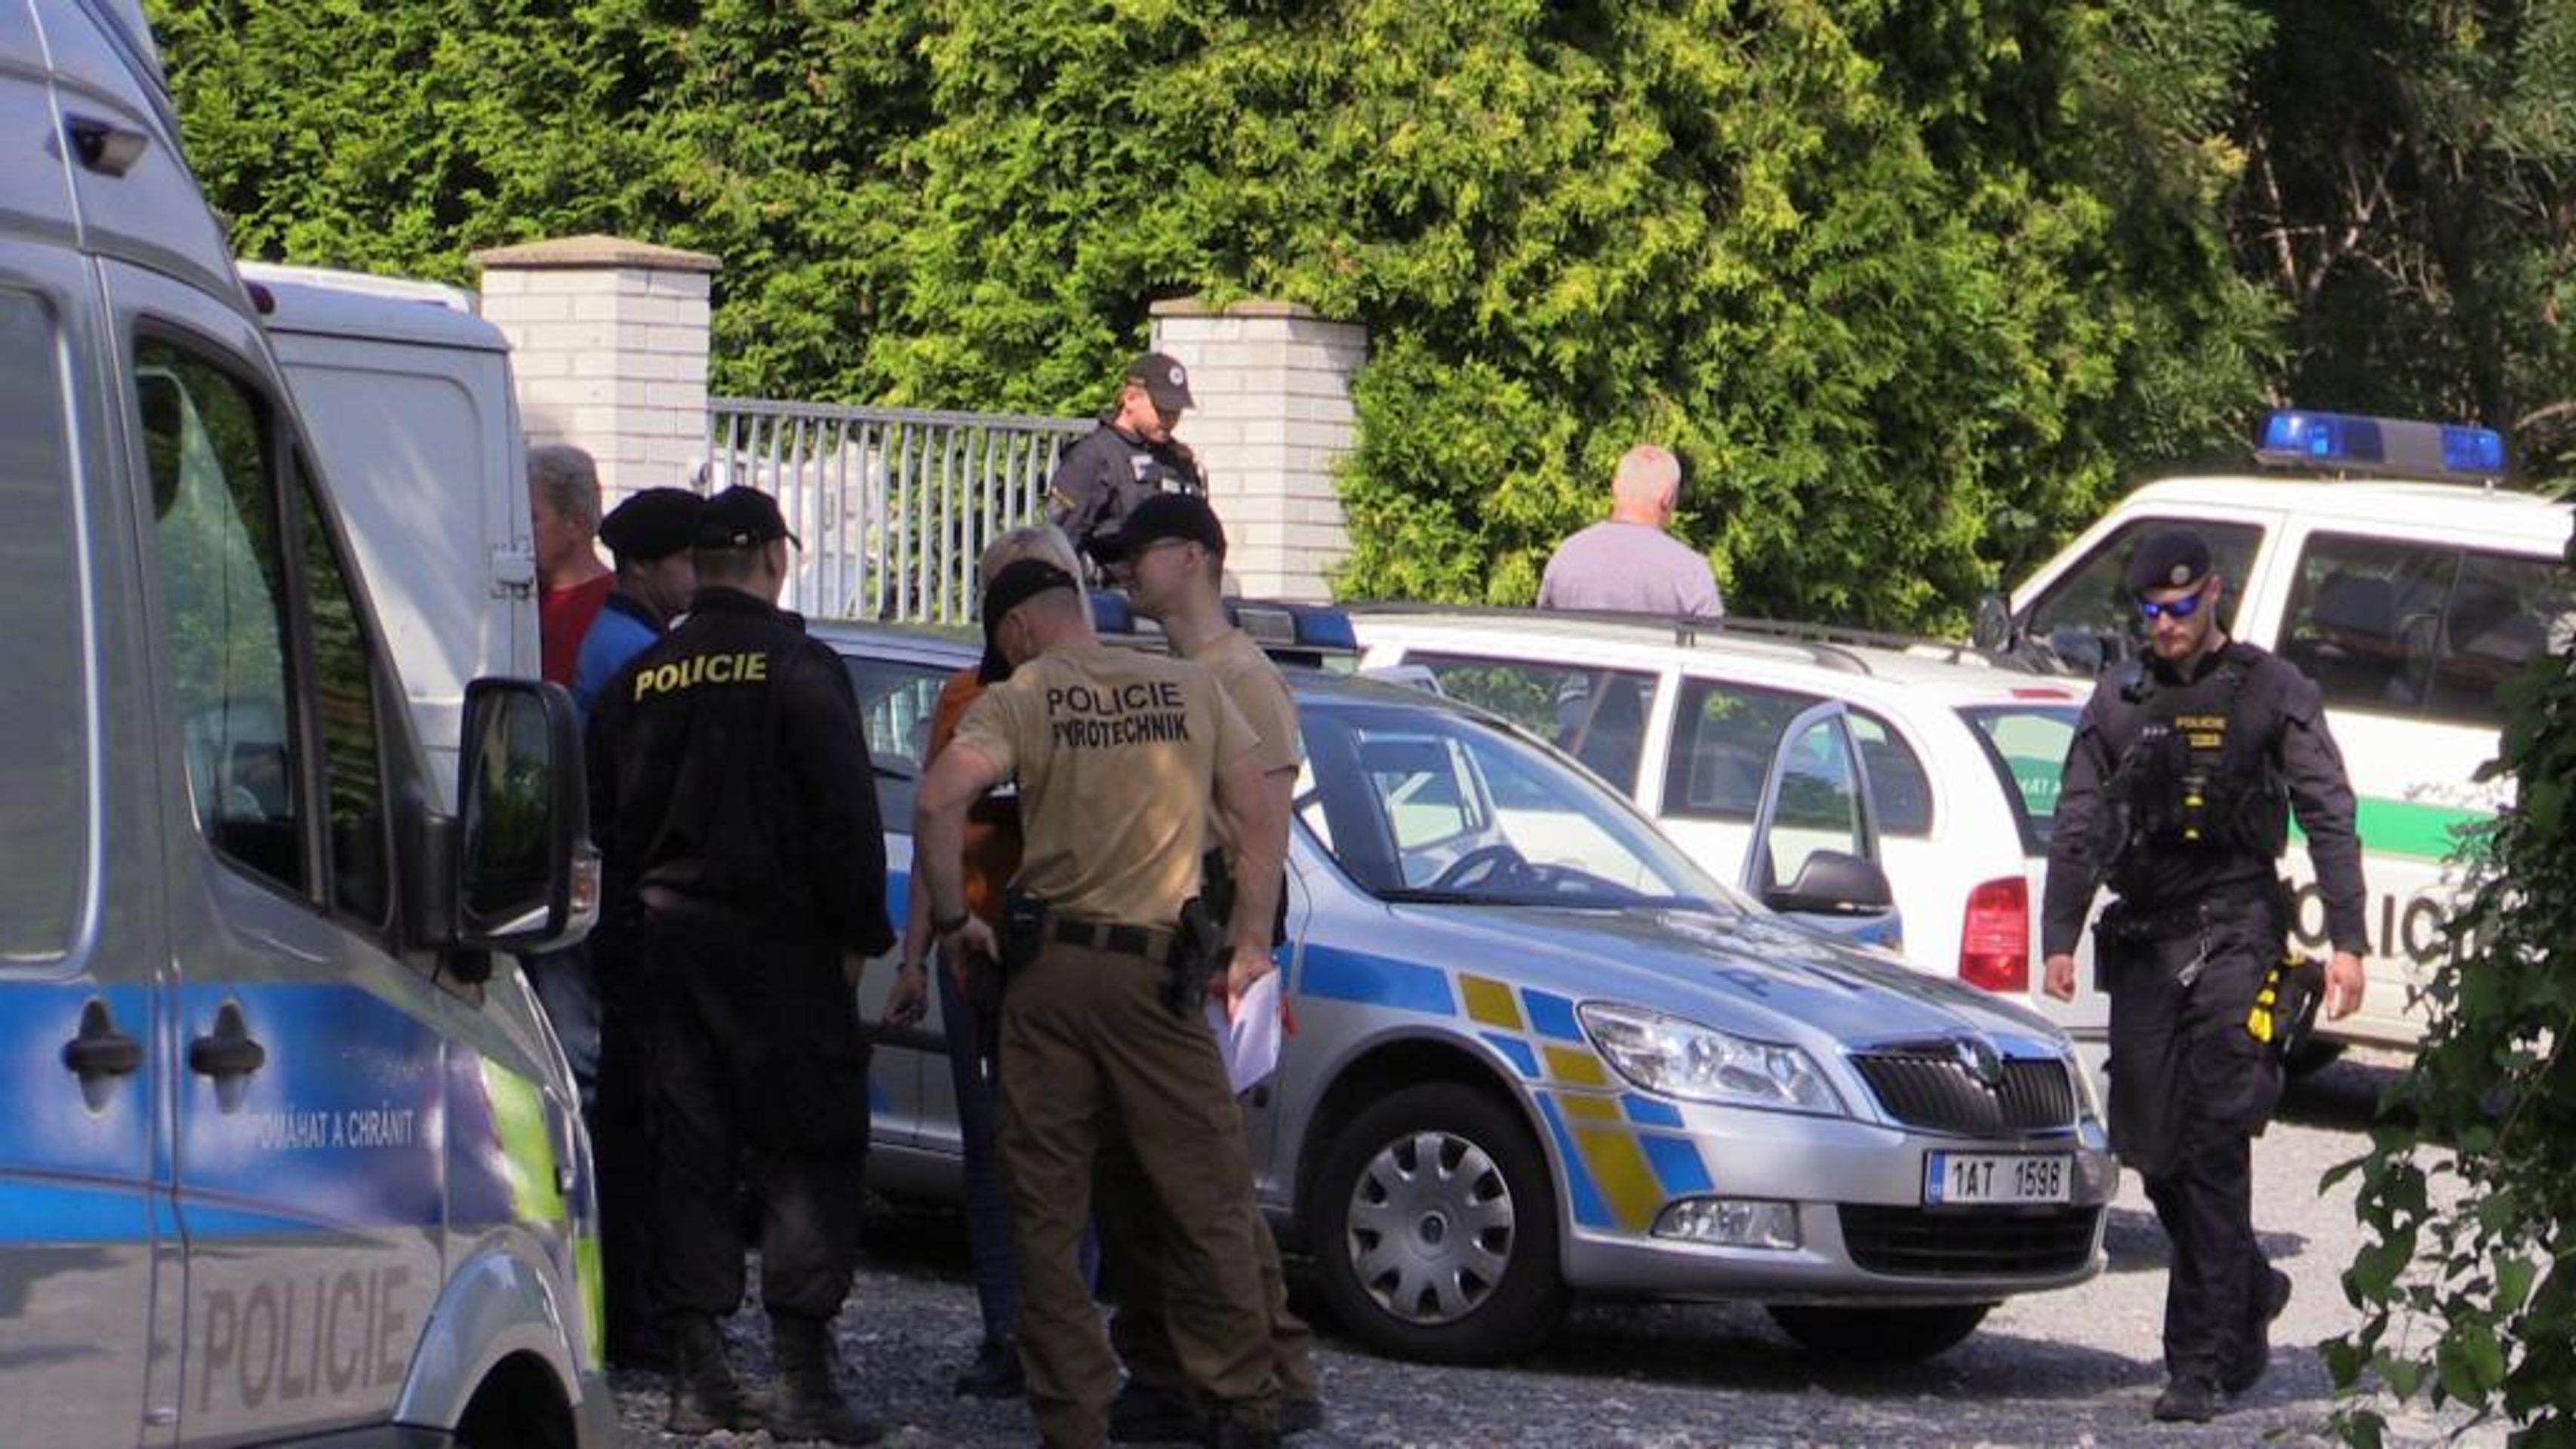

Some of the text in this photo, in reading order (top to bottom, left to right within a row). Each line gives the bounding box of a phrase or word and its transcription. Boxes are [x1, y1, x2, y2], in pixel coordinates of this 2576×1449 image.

[634, 653, 767, 703] POLICIE
[1047, 681, 1184, 715] POLICIE
[331, 1110, 344, 1148] A
[348, 1099, 414, 1148] CHRÁNIT
[1953, 1160, 2060, 1196] 1AT 1598
[201, 1267, 408, 1413] POLICIE
